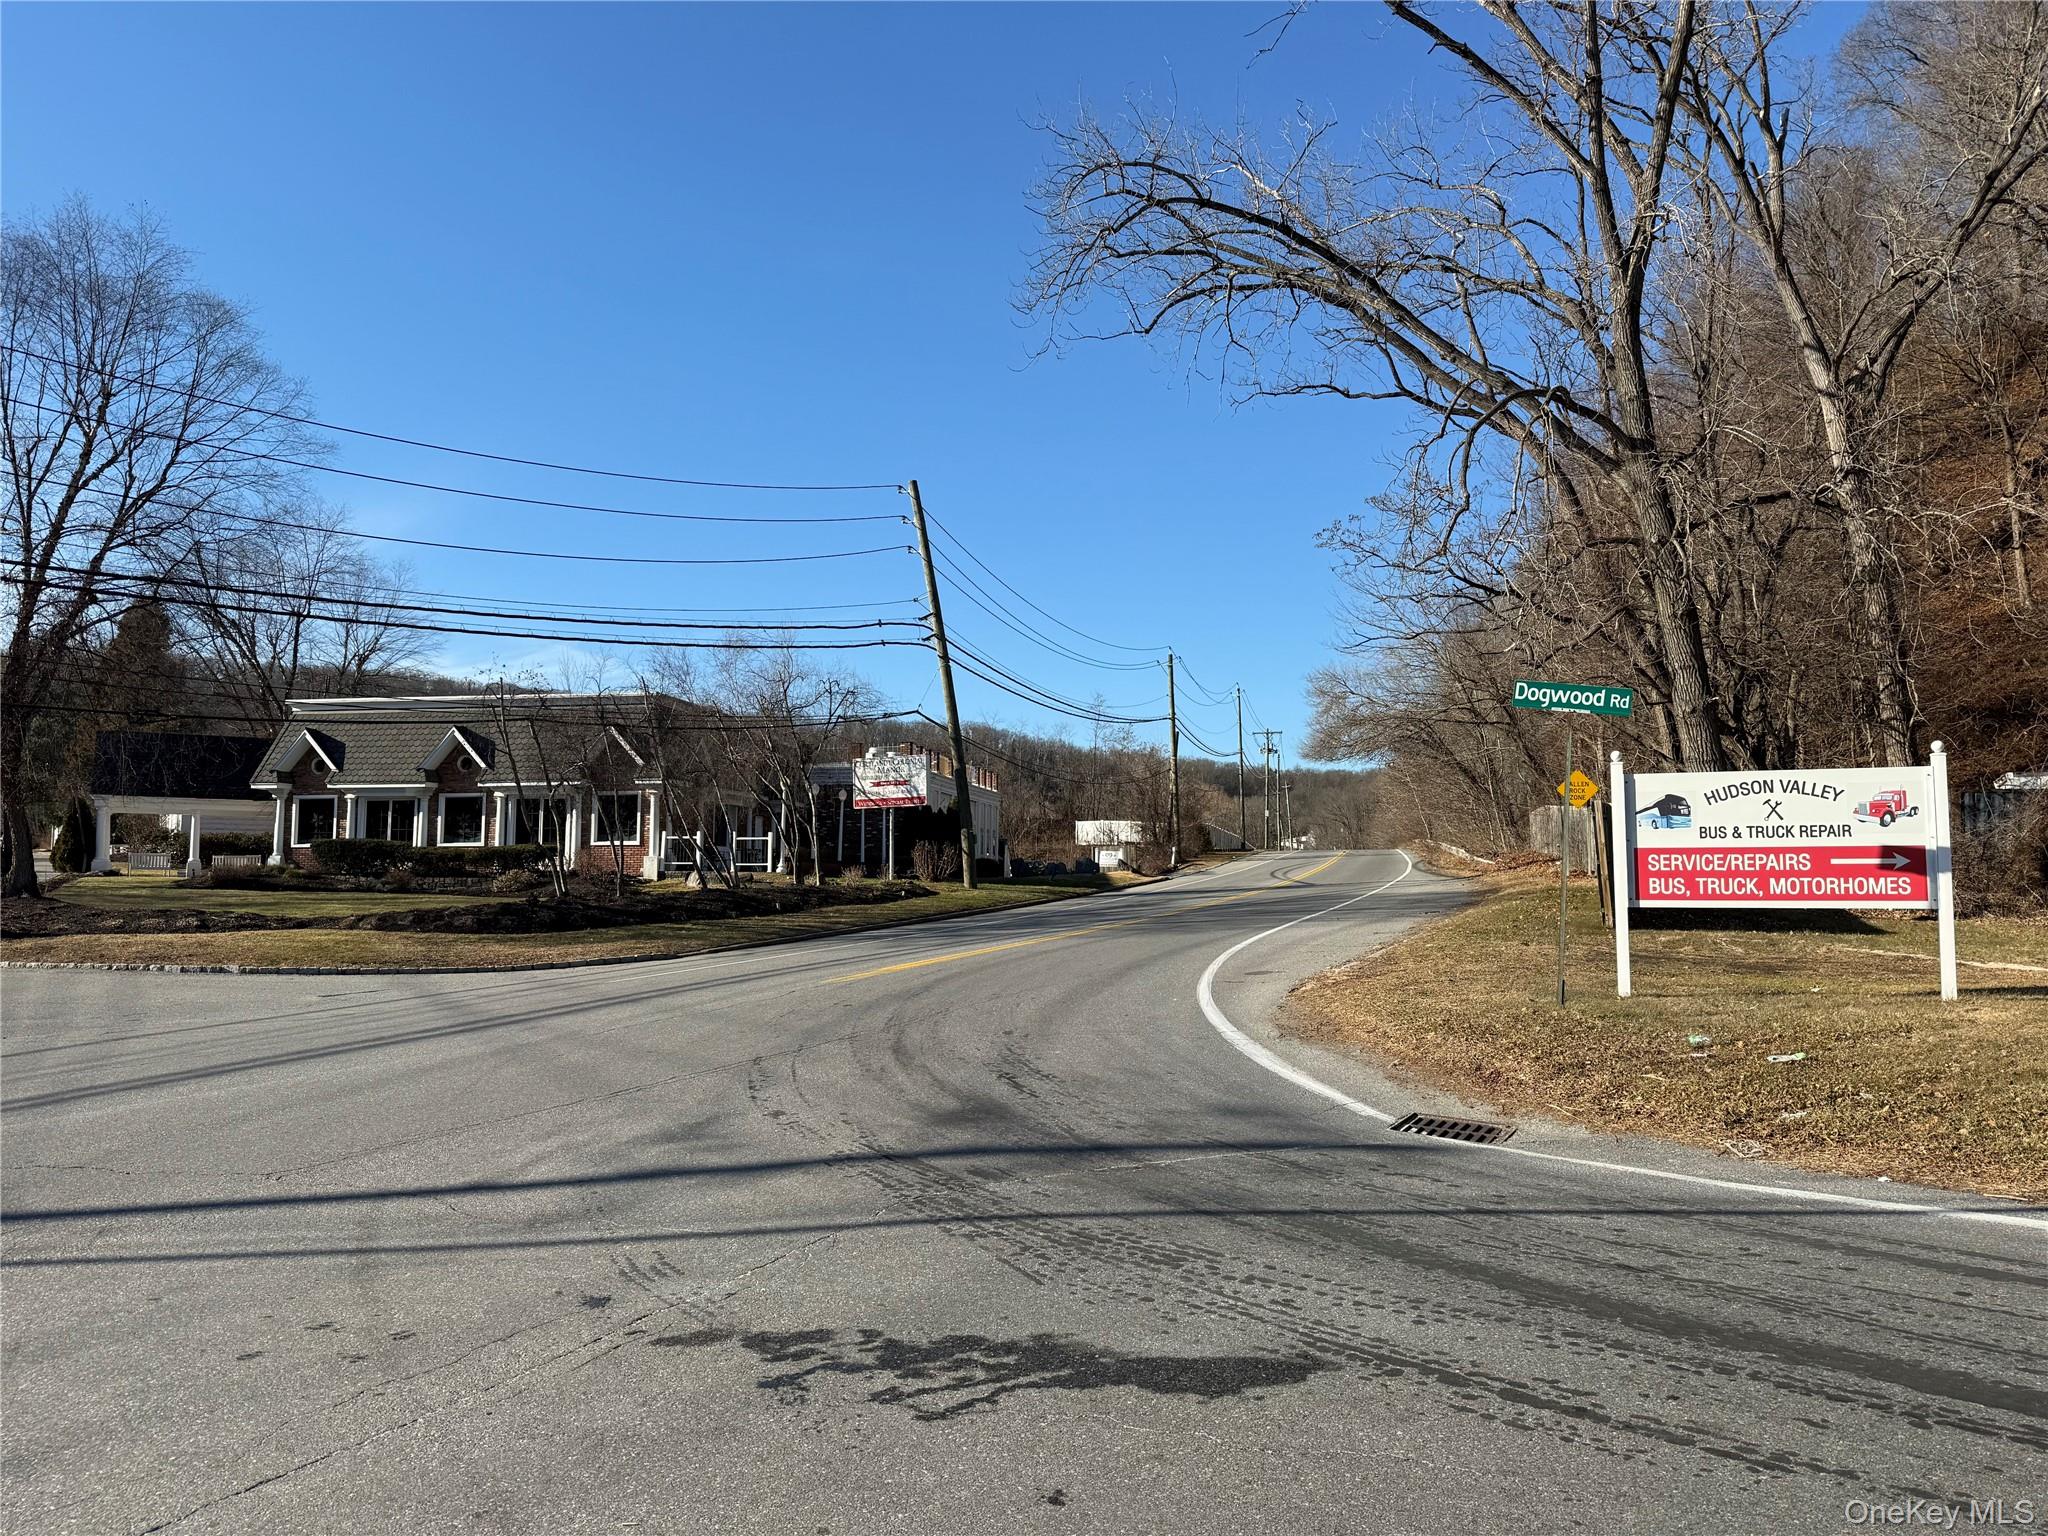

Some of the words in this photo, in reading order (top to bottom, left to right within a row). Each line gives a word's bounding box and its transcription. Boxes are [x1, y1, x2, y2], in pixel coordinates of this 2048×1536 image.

[1514, 682, 1606, 707] Dogwood
[1610, 694, 1630, 708] Rd
[1704, 779, 1774, 806] HUDSON
[1779, 779, 1845, 802] VALLEY
[1699, 826, 1727, 839] BUS
[1732, 826, 1742, 839] &
[1746, 825, 1795, 838] TRUCK
[1799, 824, 1852, 838] REPAIR
[1647, 853, 1811, 871] SERVICE/REPAIRS
[1649, 878, 1691, 897] BUS,
[1695, 878, 1763, 897] TRUCK,
[1769, 877, 1912, 895] MOTORHOMES
